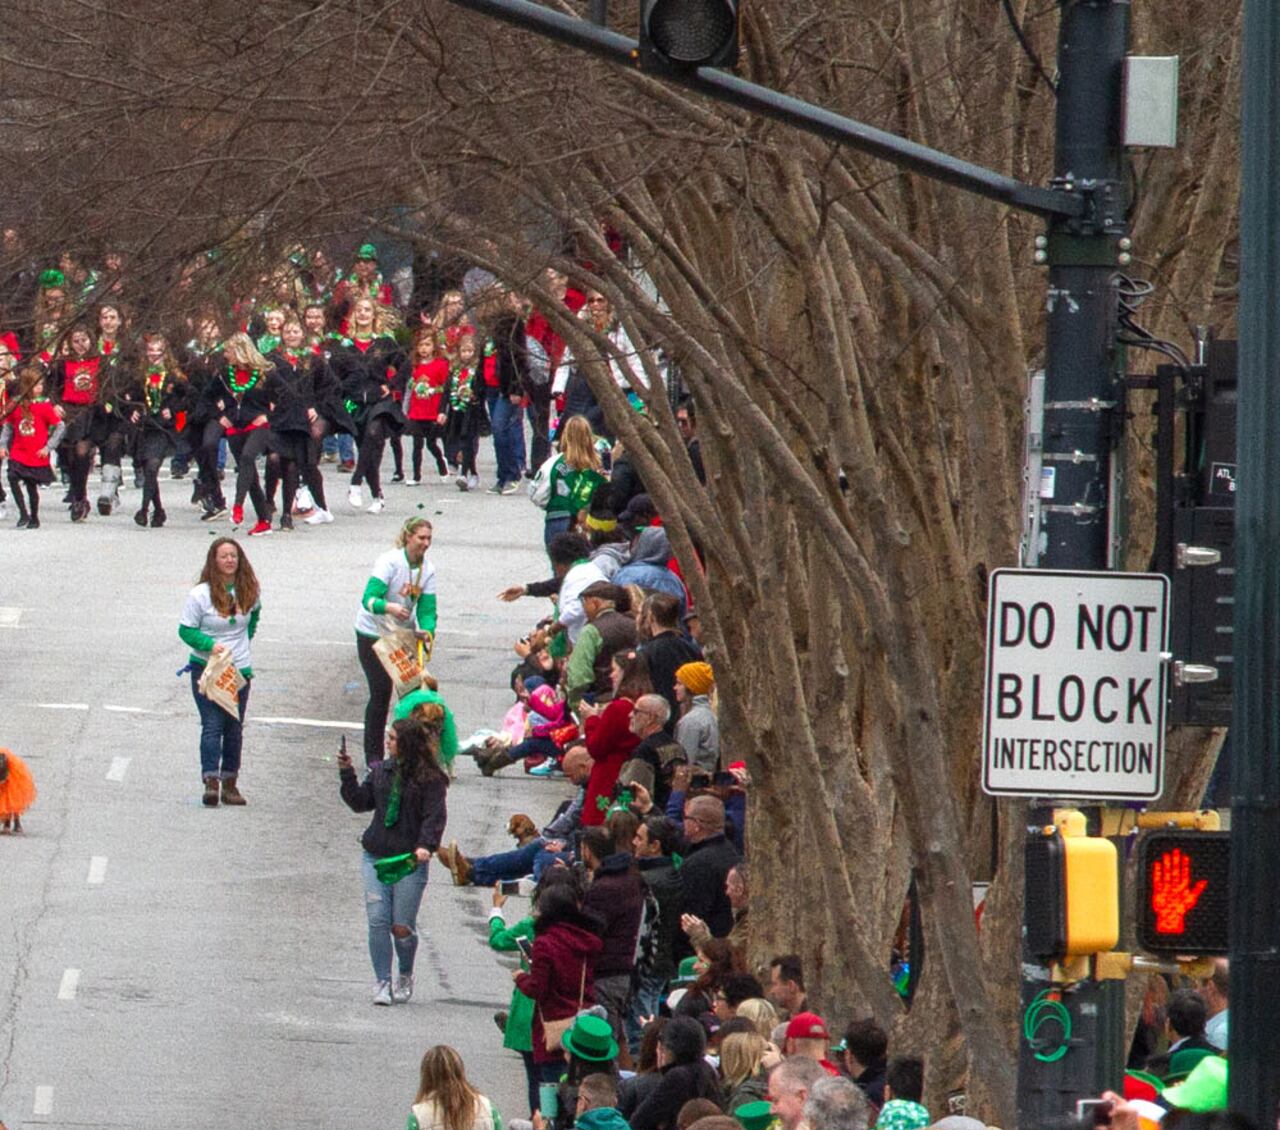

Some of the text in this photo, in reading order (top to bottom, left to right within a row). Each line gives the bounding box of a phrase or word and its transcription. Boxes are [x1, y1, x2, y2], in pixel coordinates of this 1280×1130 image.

[999, 601, 1158, 653] DO NOT
[996, 672, 1153, 725] BLOCK
[993, 737, 1154, 775] INTERSECTION
